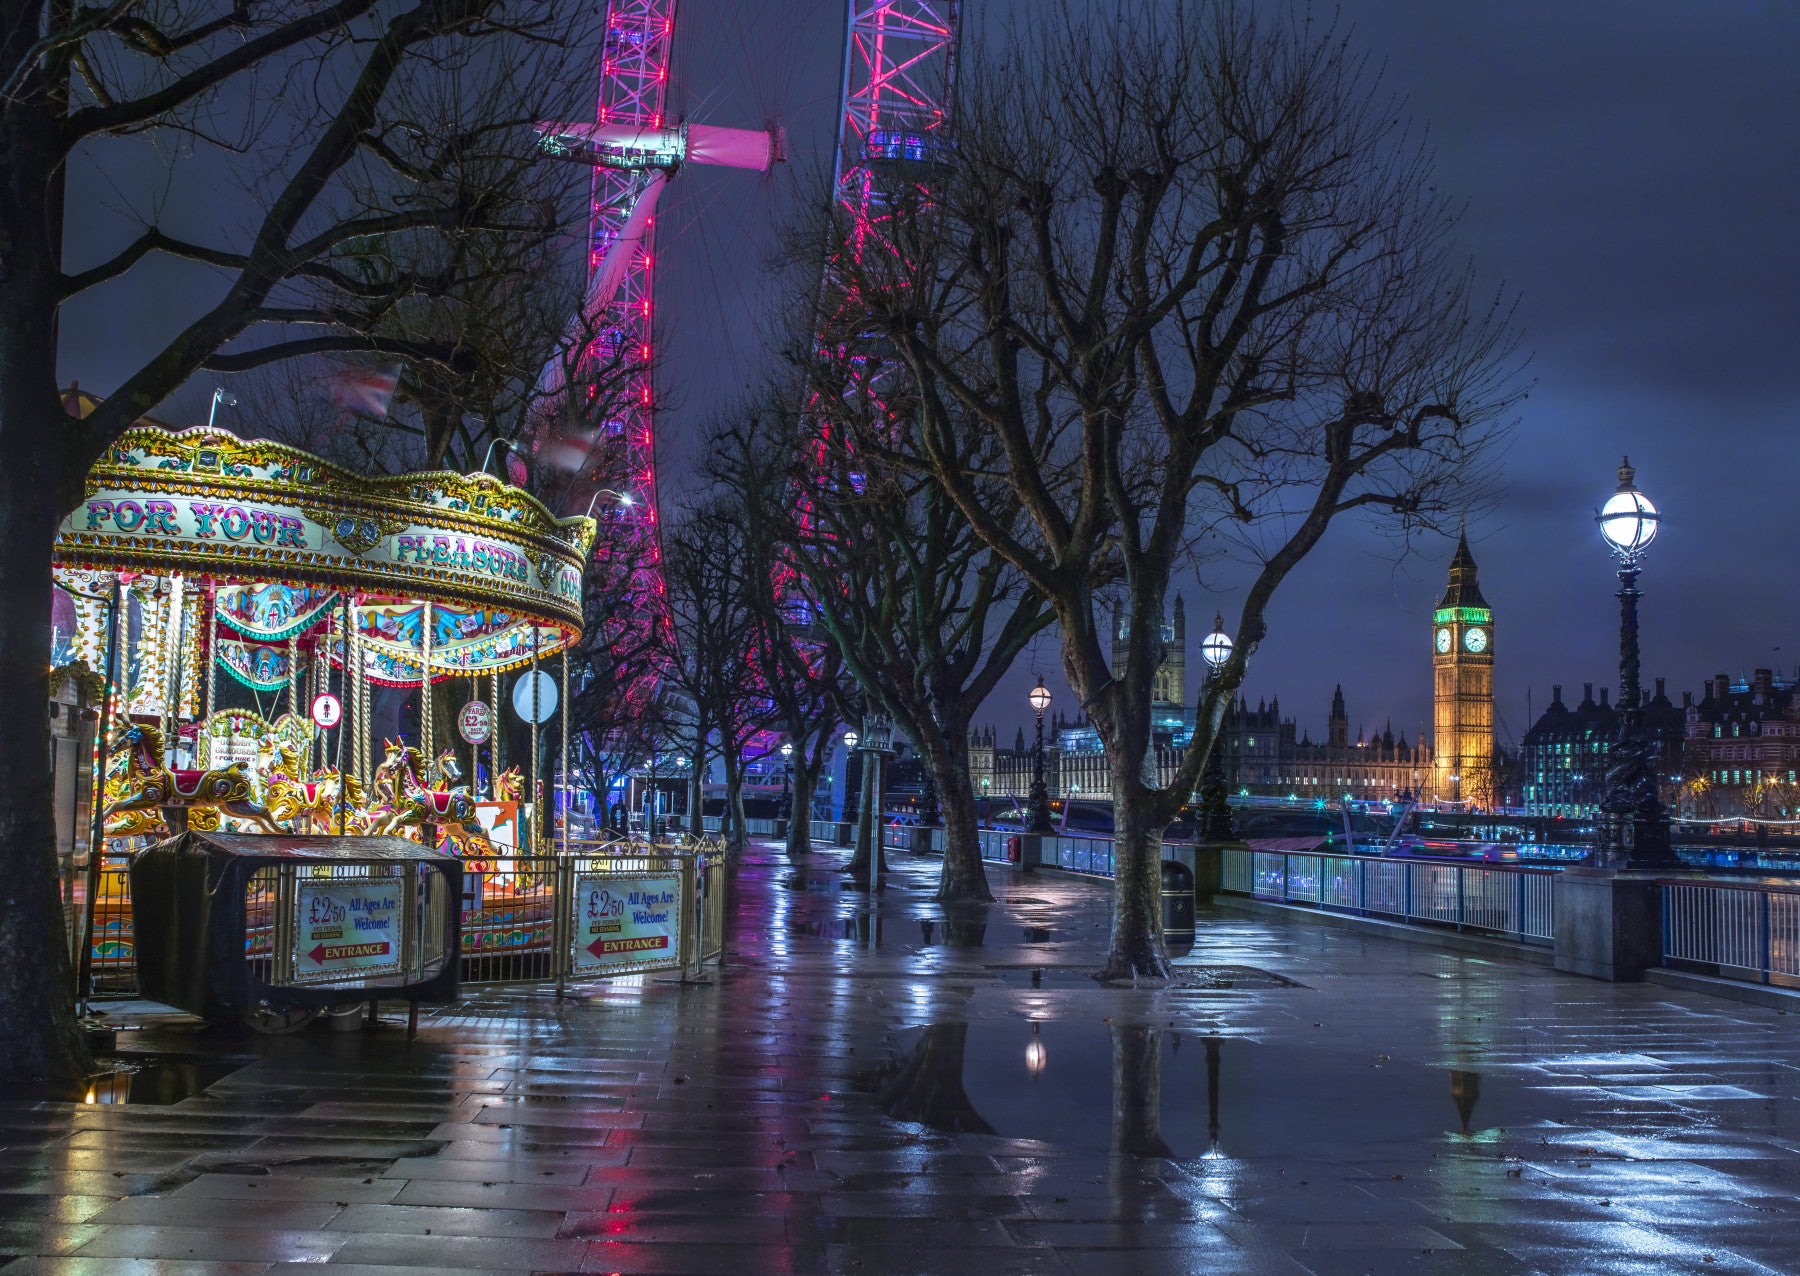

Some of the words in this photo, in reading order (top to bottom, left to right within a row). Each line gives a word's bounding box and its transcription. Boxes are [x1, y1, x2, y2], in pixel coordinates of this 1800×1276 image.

[87, 500, 181, 535] FOR
[190, 502, 308, 548] YOUR
[398, 536, 529, 582] PLEASURE
[349, 898, 360, 912] All
[362, 898, 380, 915] Ages
[382, 897, 395, 910] Are
[627, 891, 639, 905] All
[641, 892, 659, 909] Ages
[661, 891, 674, 904] Are
[354, 916, 390, 931] Welcome!
[632, 911, 669, 925] Welcome!
[325, 943, 383, 958] ENTRANCE
[603, 938, 662, 952] ENTRANCE
